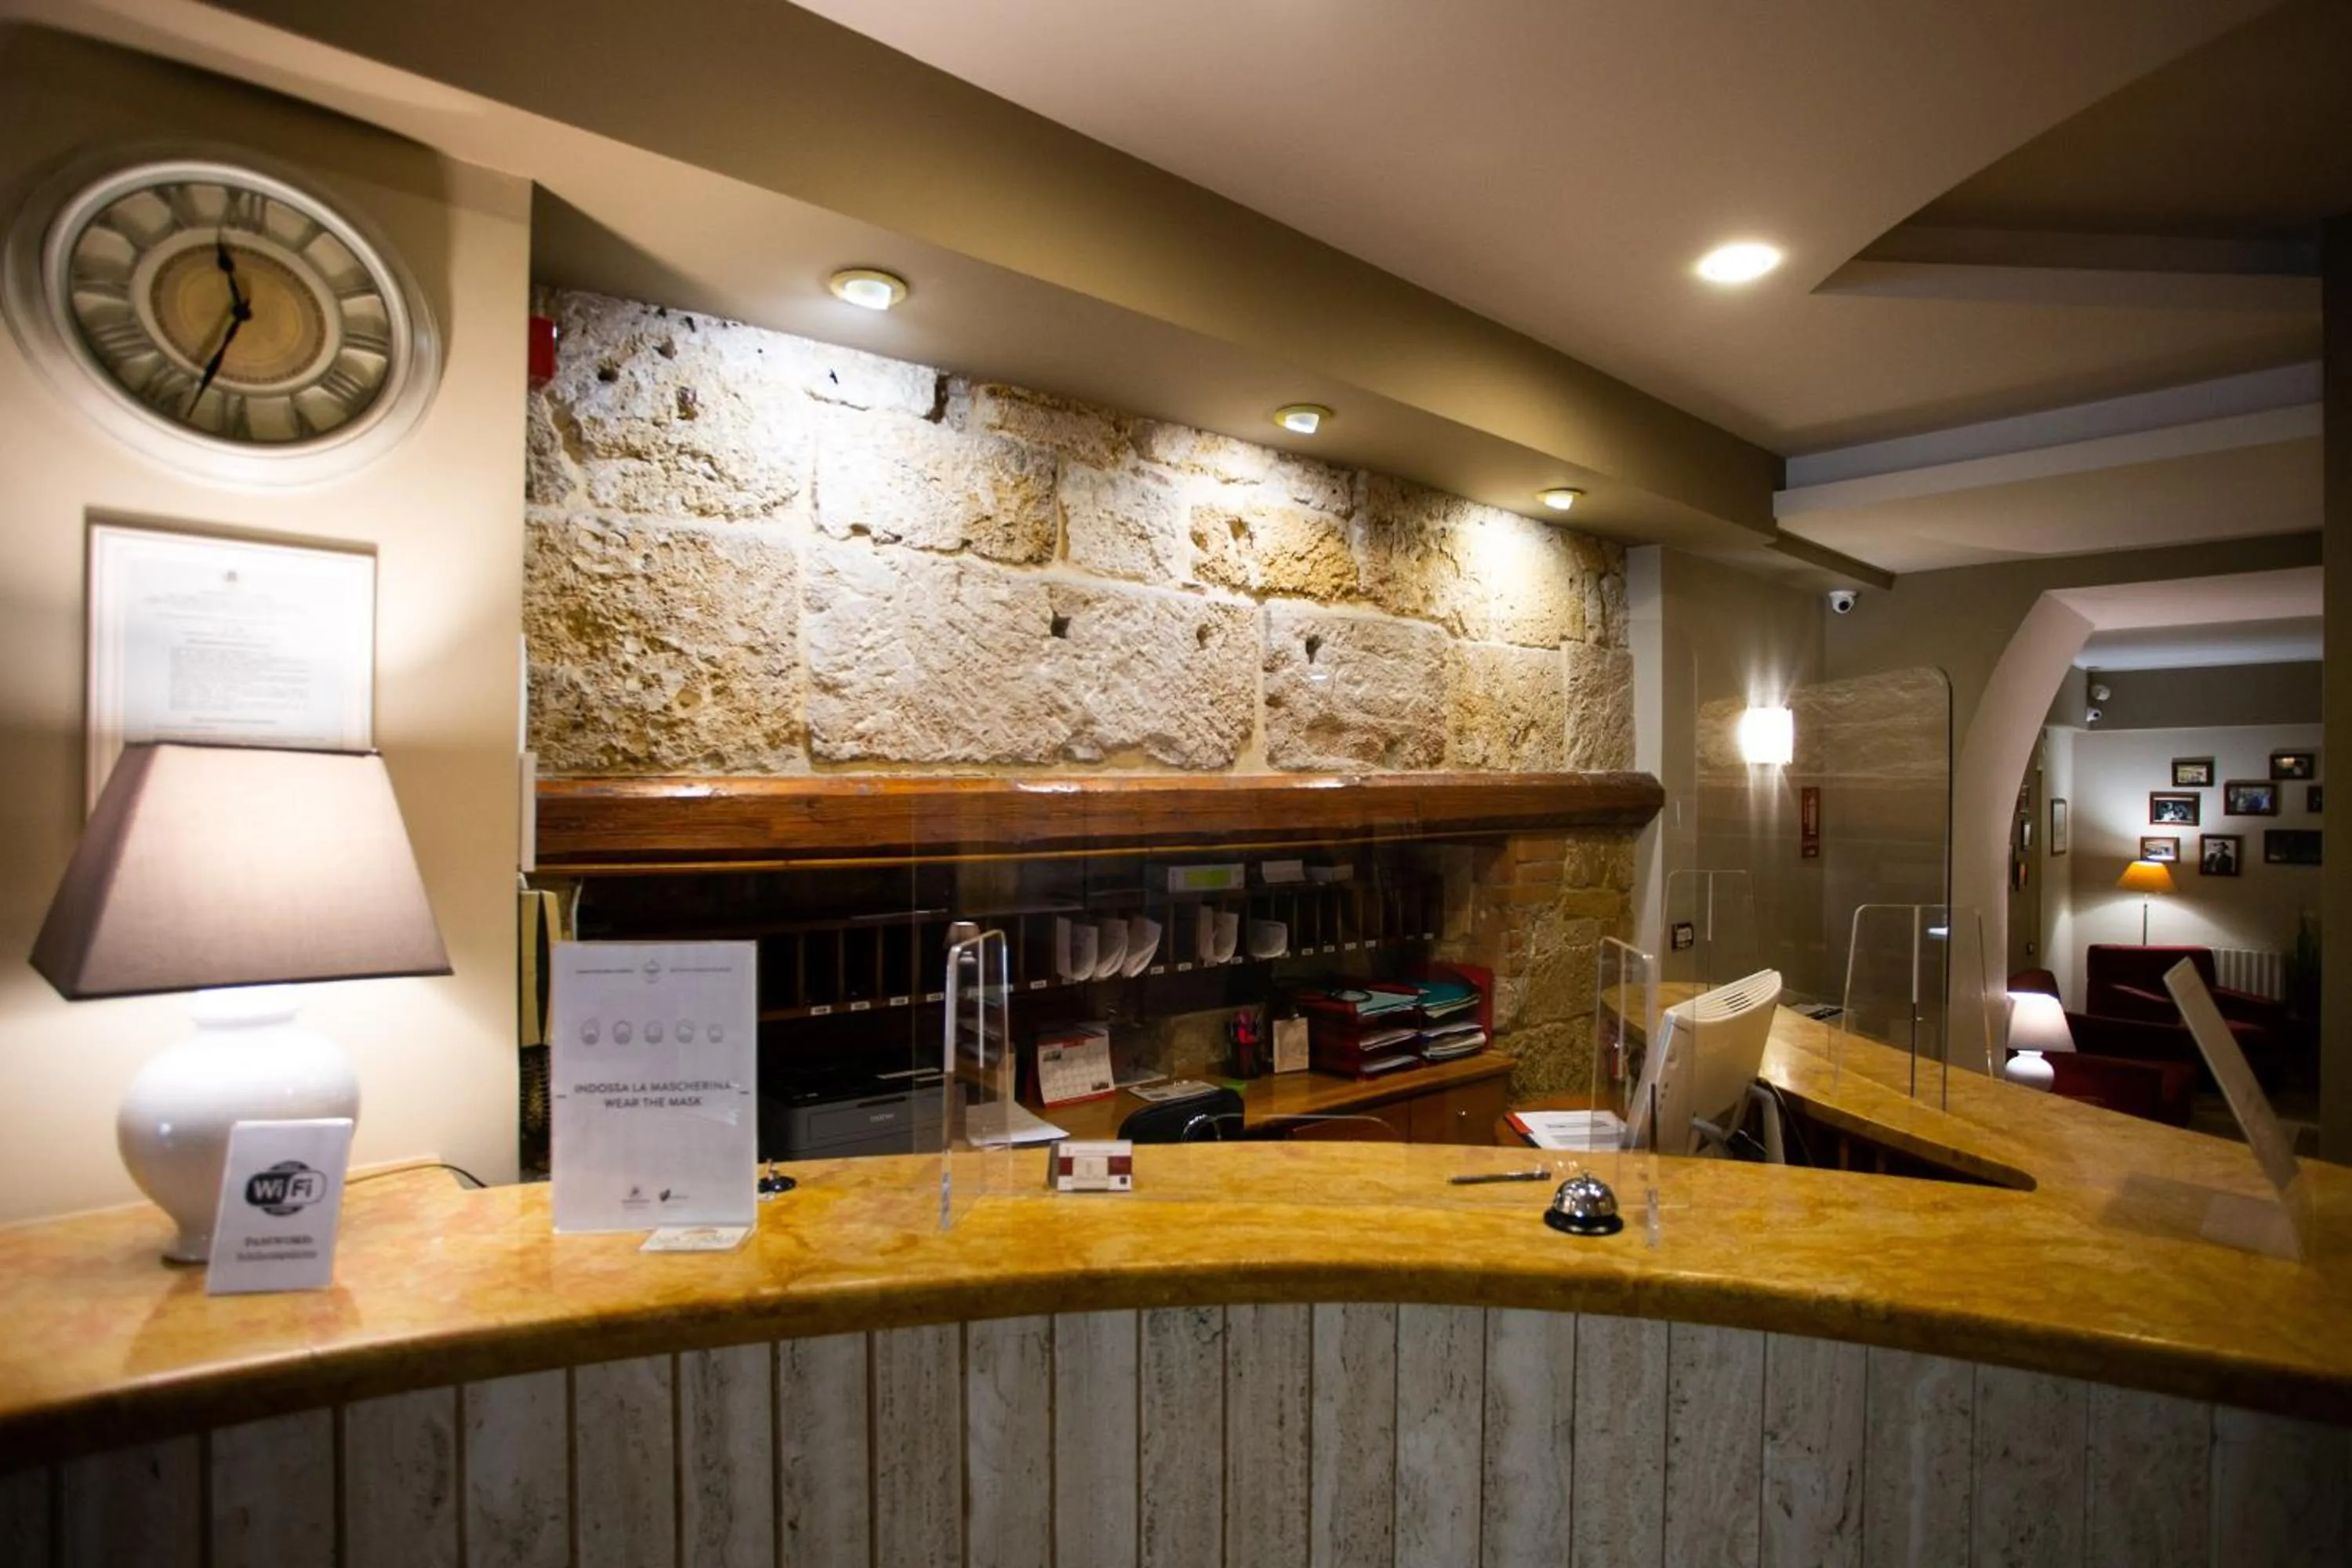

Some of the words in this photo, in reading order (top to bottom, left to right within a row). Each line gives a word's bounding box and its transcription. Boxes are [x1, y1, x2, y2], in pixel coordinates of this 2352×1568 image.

[574, 1083, 629, 1094] INDOSSA
[632, 1082, 646, 1092] LA
[650, 1080, 731, 1091] MASCHERINA
[604, 1098, 640, 1109] WEAR
[643, 1097, 665, 1107] THE
[668, 1096, 702, 1106] MASK
